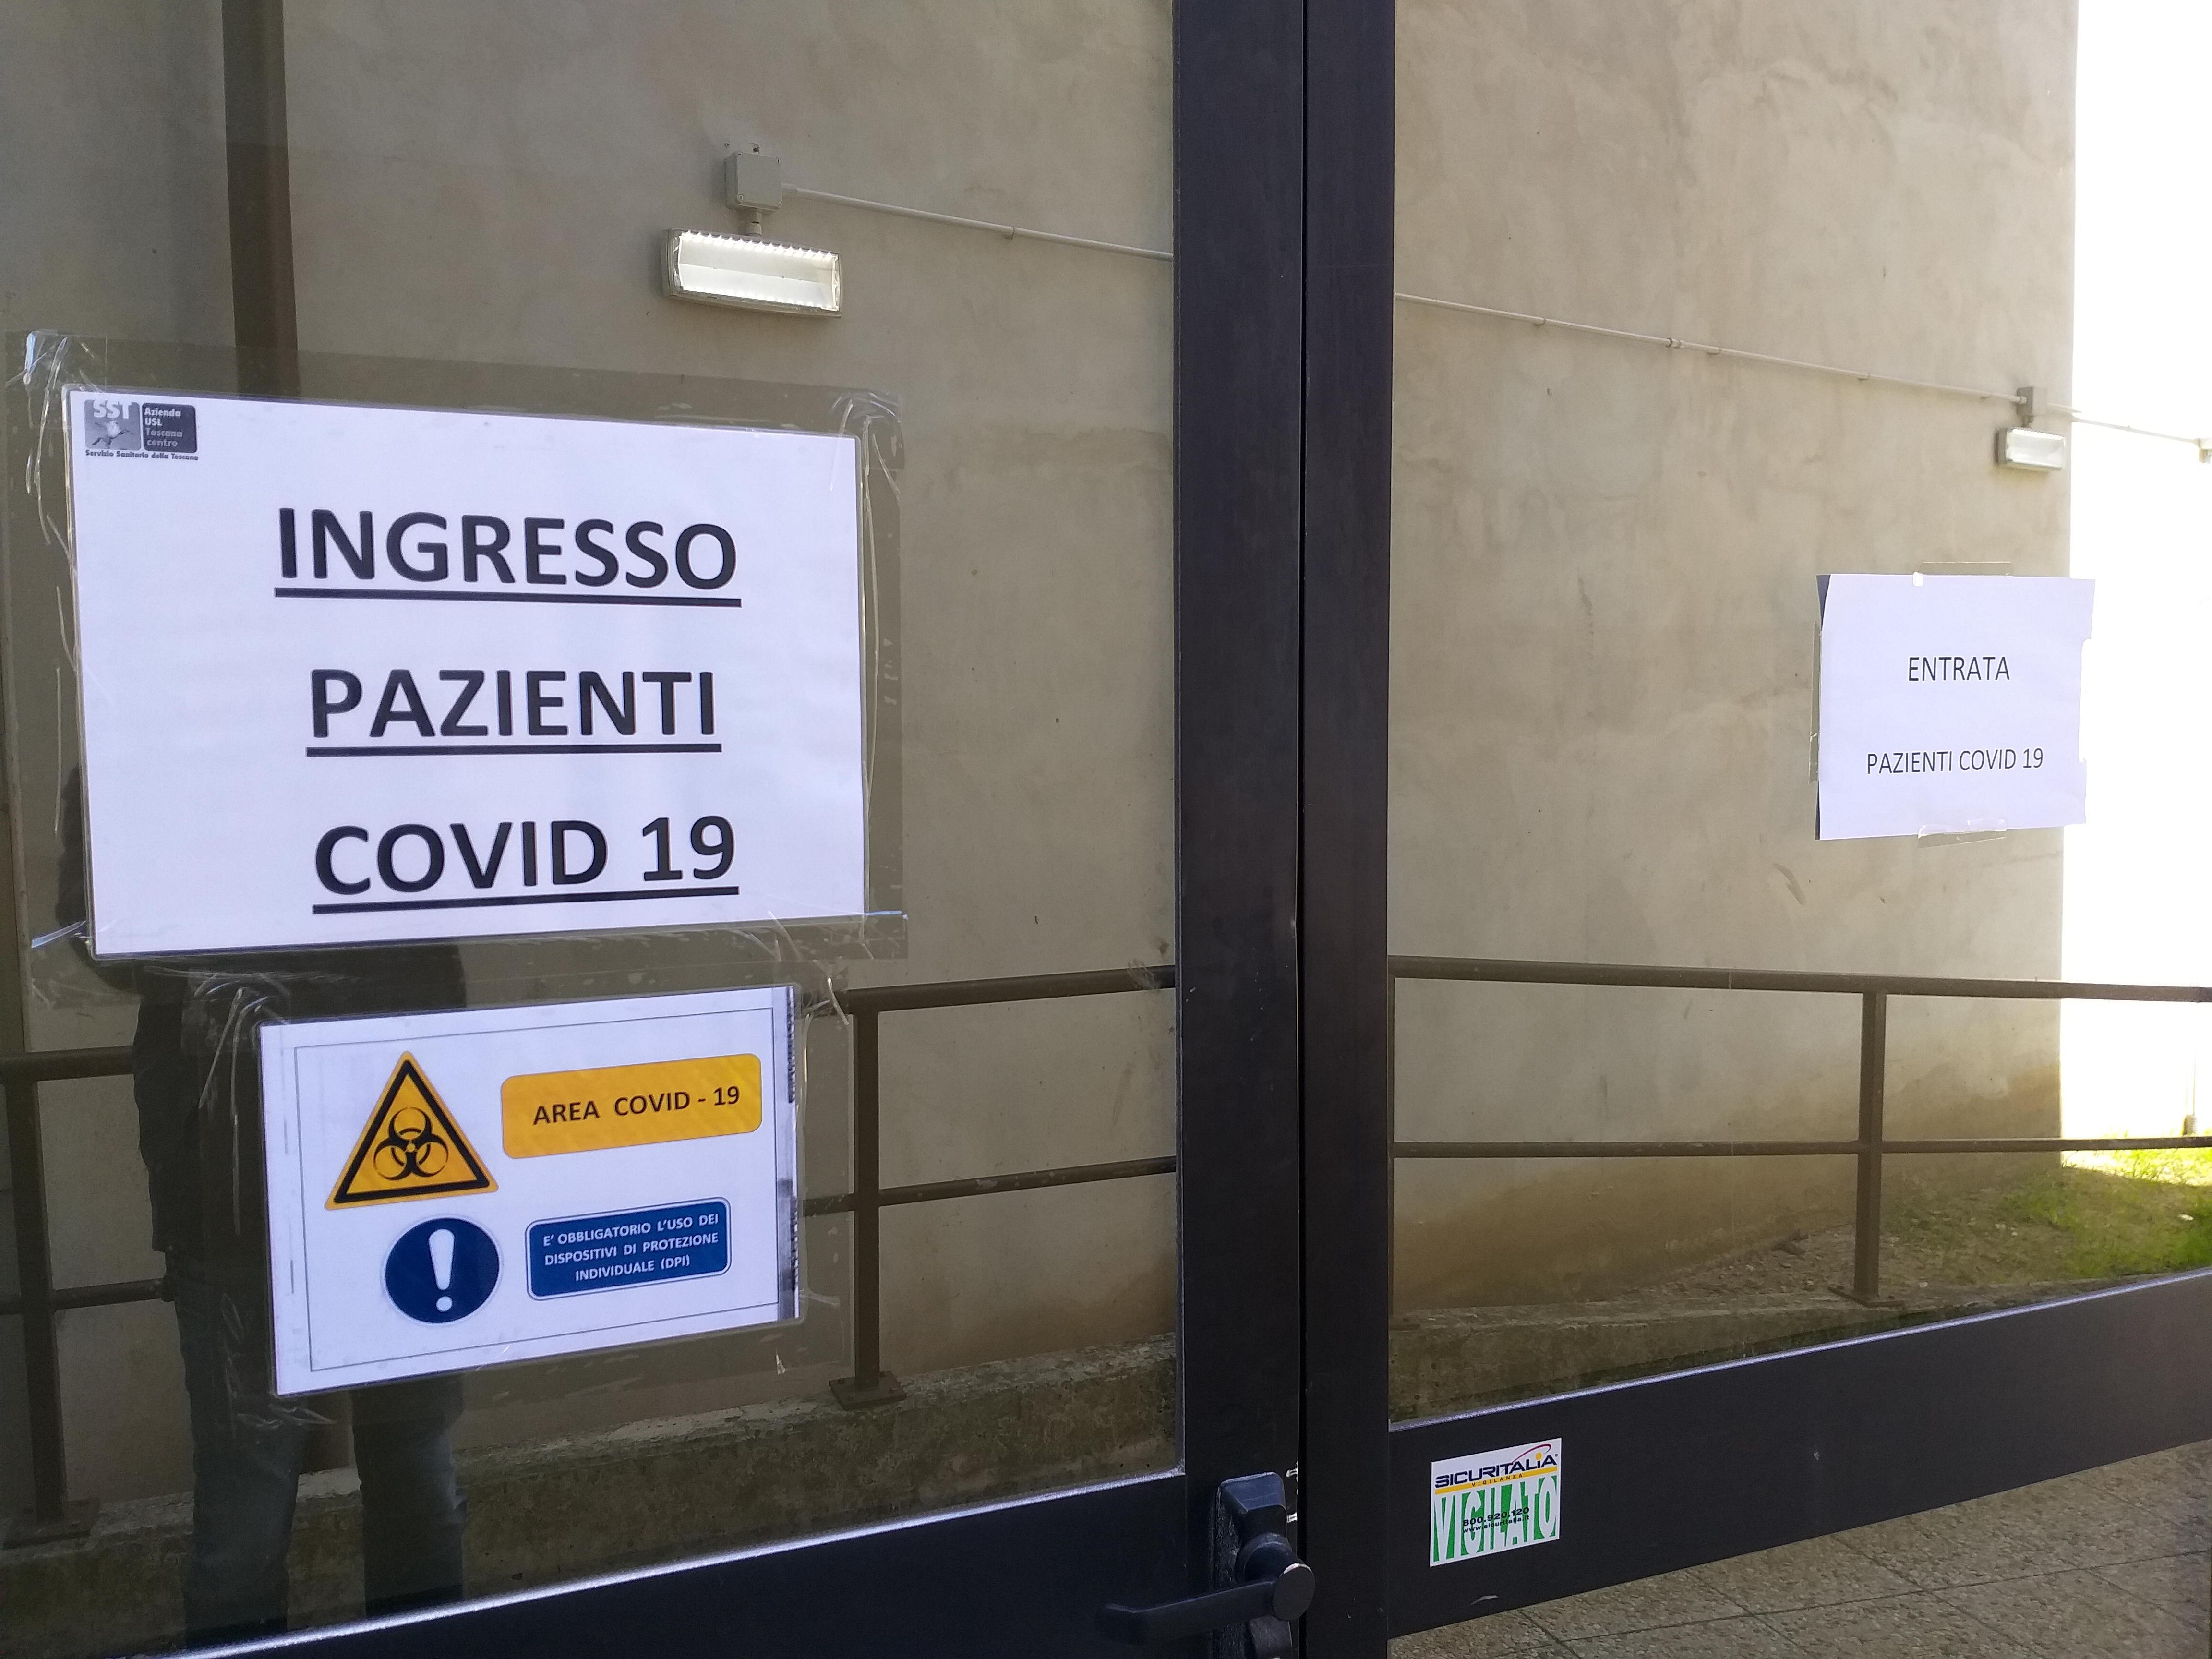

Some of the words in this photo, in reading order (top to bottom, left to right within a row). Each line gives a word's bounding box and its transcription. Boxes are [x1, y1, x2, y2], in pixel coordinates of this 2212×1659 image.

[93, 398, 132, 419] SST
[144, 407, 181, 417] Azienda
[144, 418, 163, 426] USL
[145, 427, 183, 437] Toscana
[146, 439, 178, 447] centro
[278, 507, 736, 589] INGRESSO
[1908, 656, 2010, 682] ENTRATA
[309, 669, 715, 738] PAZIENTI
[1866, 751, 1953, 775] PAZIENTI
[1959, 749, 2017, 771] COVID
[2022, 748, 2044, 769] 19
[314, 819, 608, 895] COVID
[641, 815, 735, 881] 19
[532, 1100, 601, 1126] AREA
[613, 1091, 691, 1116] COVID
[713, 1085, 740, 1106] 19
[542, 1234, 555, 1247] E'
[557, 1222, 651, 1245] OBBLIGATORIO
[657, 1217, 693, 1232] L'USO
[698, 1213, 719, 1226] DEI
[544, 1246, 617, 1266] DISPOSITIVI
[623, 1243, 637, 1256] DI
[642, 1232, 719, 1252] PROTEZIONE
[575, 1260, 655, 1281] INDIVIDUALE
[660, 1254, 690, 1271] (DPI)
[1471, 1473, 1523, 1487] VIGILANZA
[1433, 1475, 1558, 1562] VIGILATO
[1462, 1506, 1530, 1527] 800.920.120
[1462, 1515, 1530, 1533] www.sicuritalia.it
